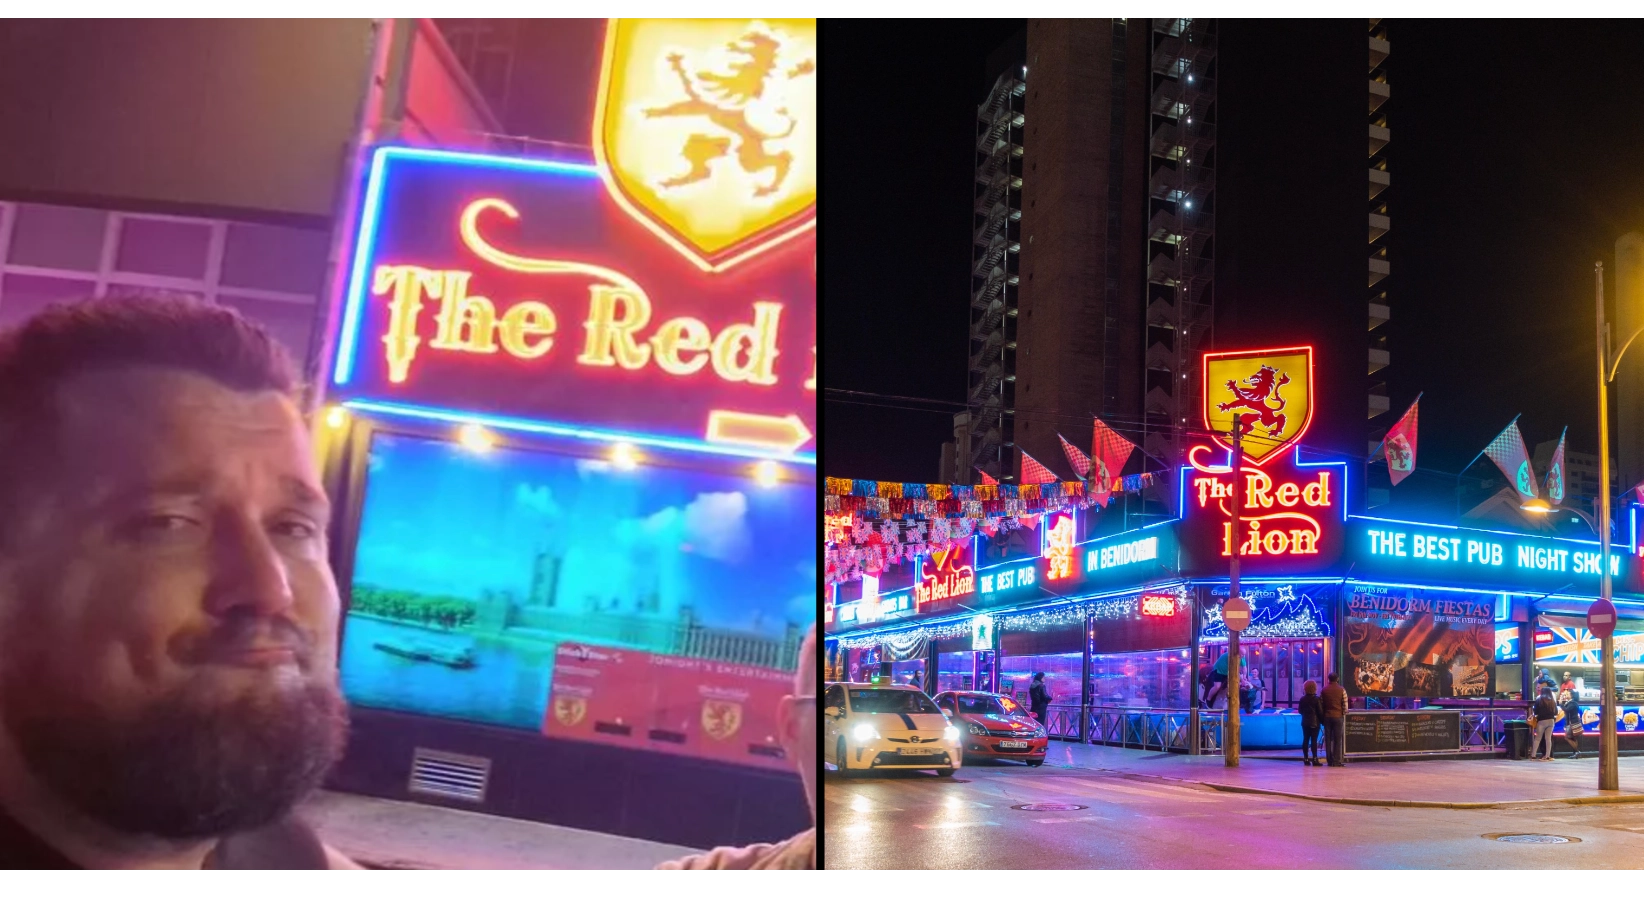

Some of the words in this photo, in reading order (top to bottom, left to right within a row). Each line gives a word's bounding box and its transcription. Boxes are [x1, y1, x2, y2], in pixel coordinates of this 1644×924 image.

[373, 265, 557, 383] The
[577, 283, 783, 386] Red
[1244, 472, 1331, 508] Red
[1087, 549, 1099, 572] IN
[1368, 530, 1407, 557] THE
[1413, 533, 1461, 561] BEST
[1467, 541, 1503, 566] PUB
[1518, 546, 1569, 572] NIGHT
[931, 575, 949, 601] Red
[950, 570, 975, 598] Lion
[981, 574, 993, 593] THE
[997, 568, 1015, 590] BEST
[1018, 566, 1036, 587] PUB
[1354, 585, 1368, 593] JOIN
[1368, 586, 1376, 594] US
[1377, 586, 1388, 595] FOR
[1246, 589, 1276, 597] Fulton
[1350, 594, 1432, 613] BENIDORM
[1434, 600, 1491, 617] FIESTAS
[1434, 615, 1446, 623] LIVE
[1446, 616, 1461, 624] MUSIC
[1477, 617, 1488, 625] DAY
